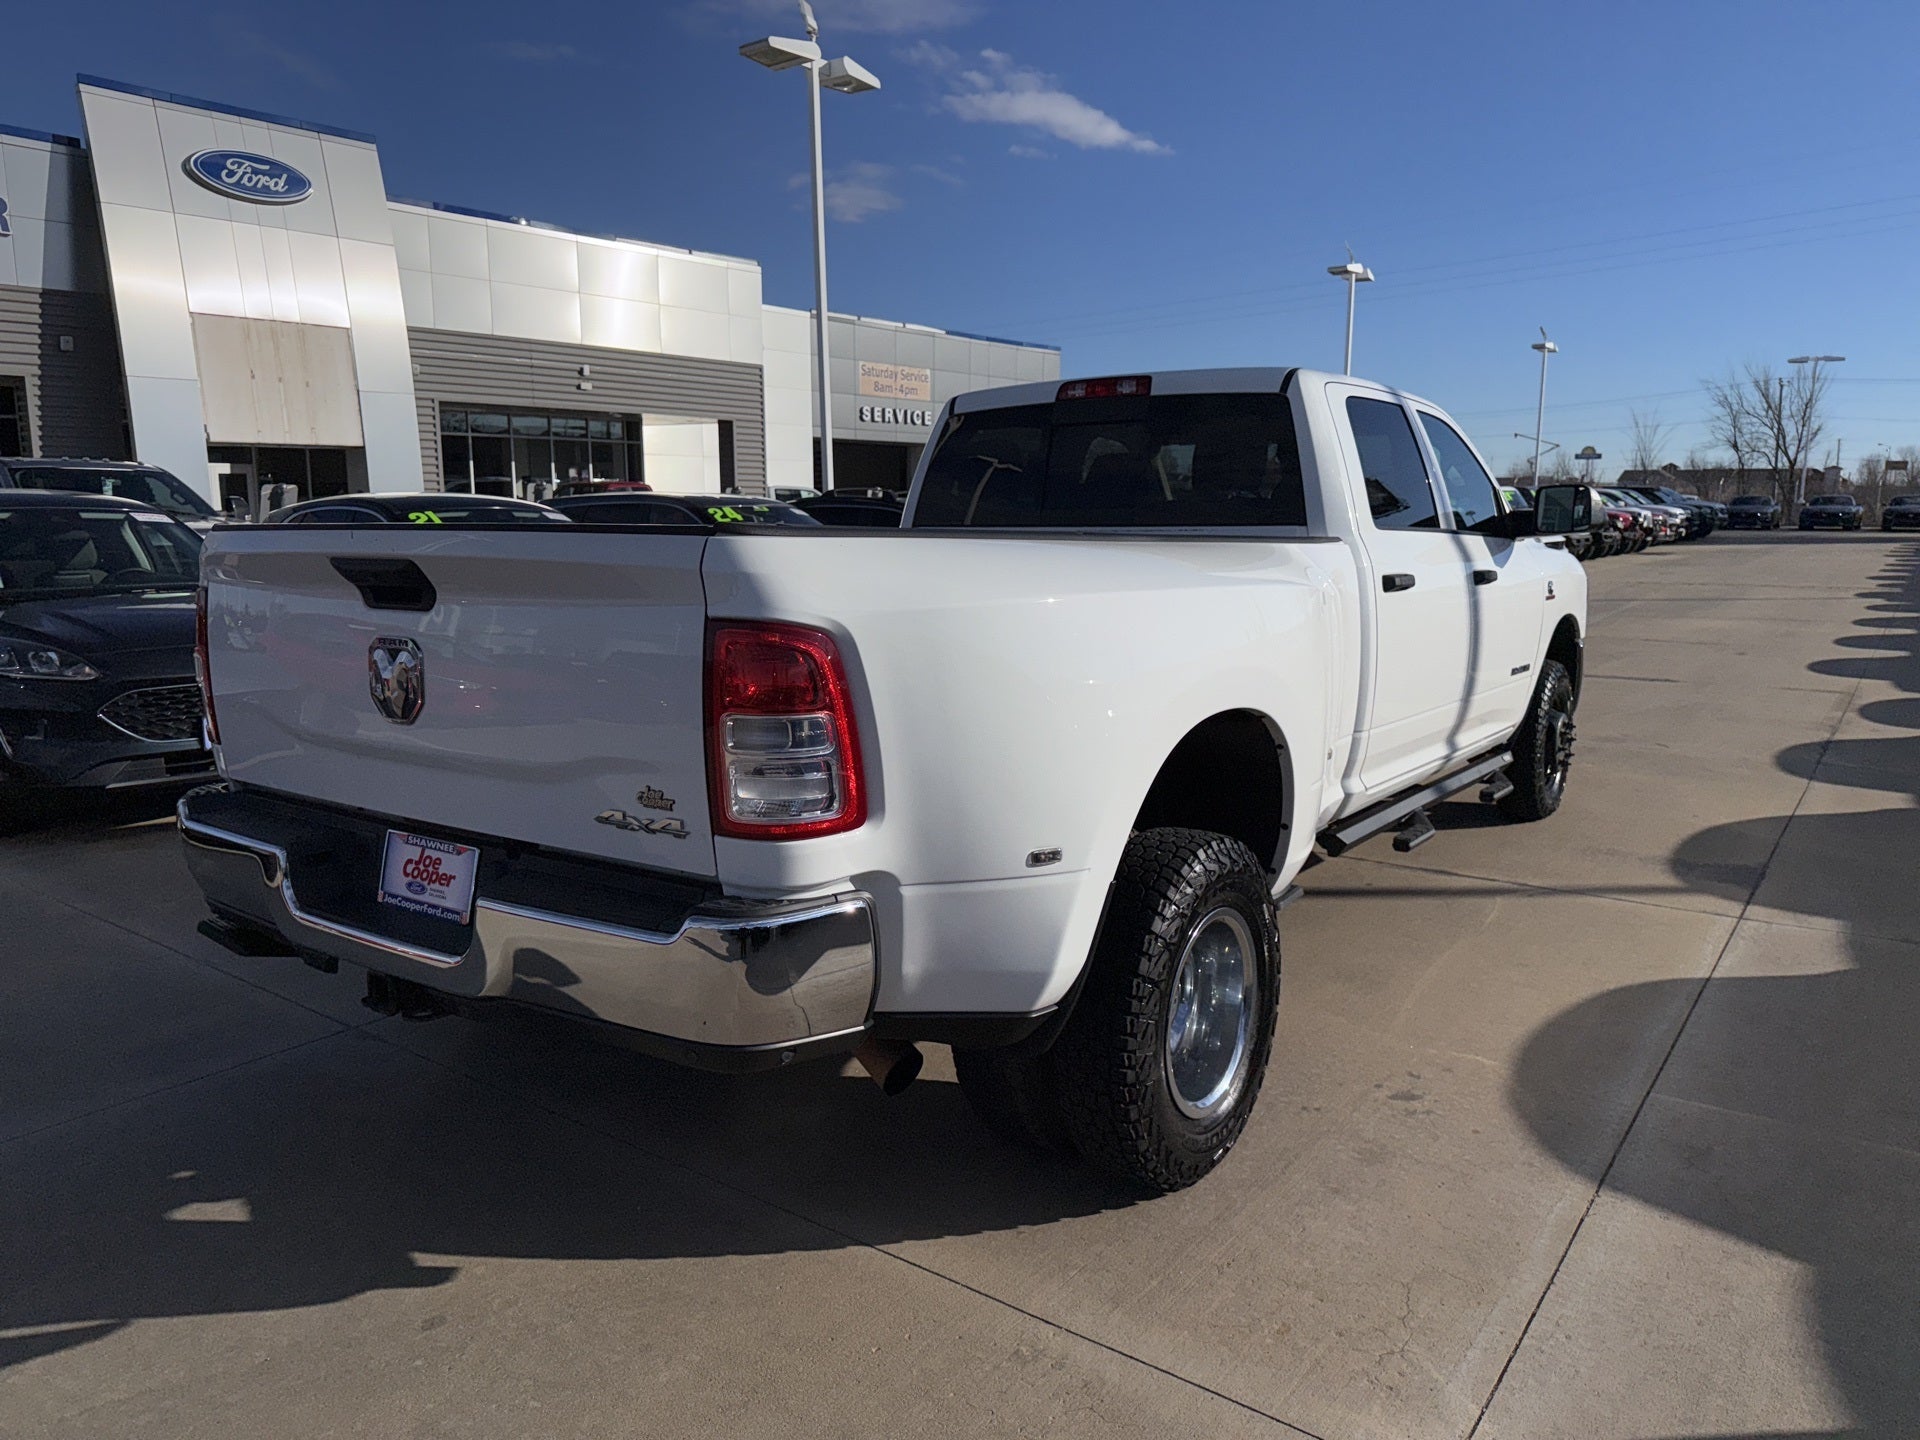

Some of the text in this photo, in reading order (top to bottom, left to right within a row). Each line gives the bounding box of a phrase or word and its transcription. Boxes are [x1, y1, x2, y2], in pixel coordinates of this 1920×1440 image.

[221, 158, 288, 192] Ford
[861, 364, 929, 384] Saturday Service
[859, 405, 932, 426] SERVICE
[707, 506, 744, 522] 24
[377, 638, 409, 648] RAM
[414, 847, 442, 870] Joe
[402, 858, 456, 888] Cooper
[383, 893, 460, 922] JoeCooperFord.com
